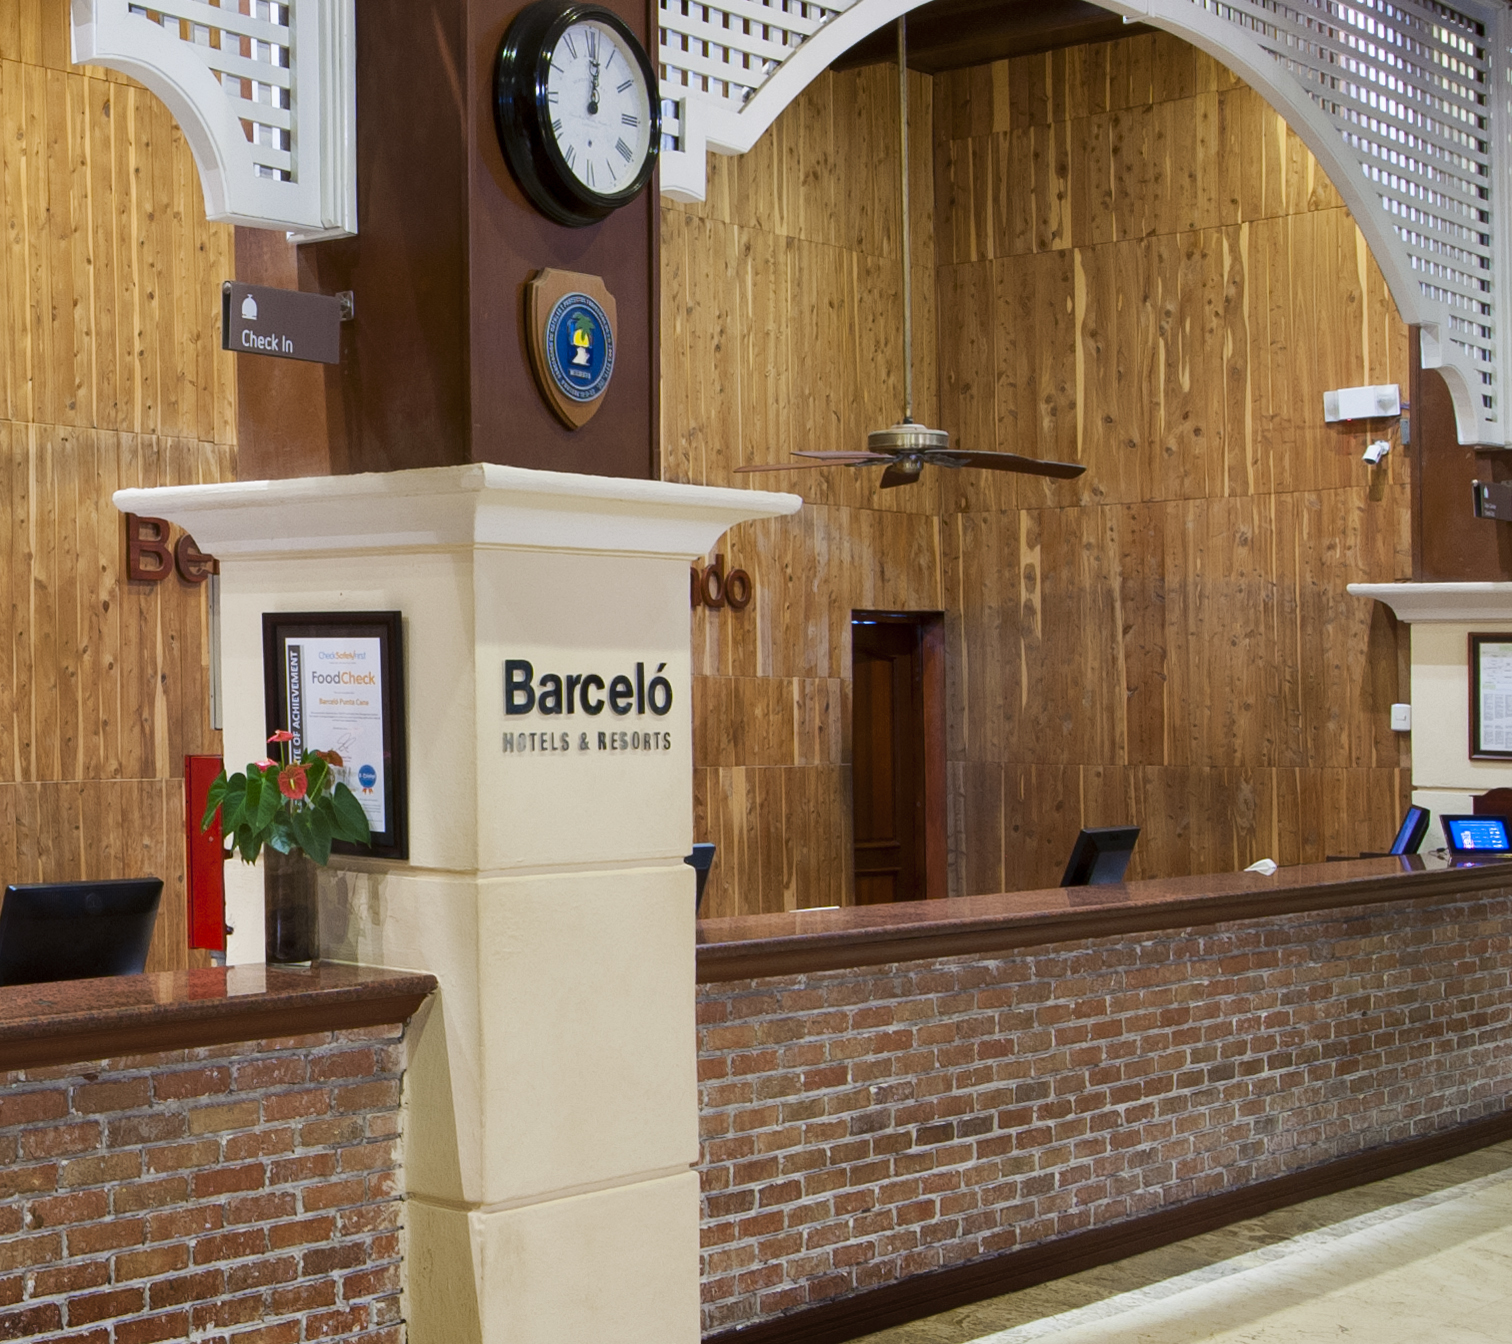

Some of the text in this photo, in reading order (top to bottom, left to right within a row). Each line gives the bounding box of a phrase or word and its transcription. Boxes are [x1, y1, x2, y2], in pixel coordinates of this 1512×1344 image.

[241, 328, 294, 354] Check In
[289, 650, 301, 729] ACHIEVEMENT
[311, 670, 376, 685] FoodCheck
[504, 659, 674, 716] Barceló
[293, 731, 301, 747] OF
[502, 731, 673, 753] HOTELS & RESORTS
